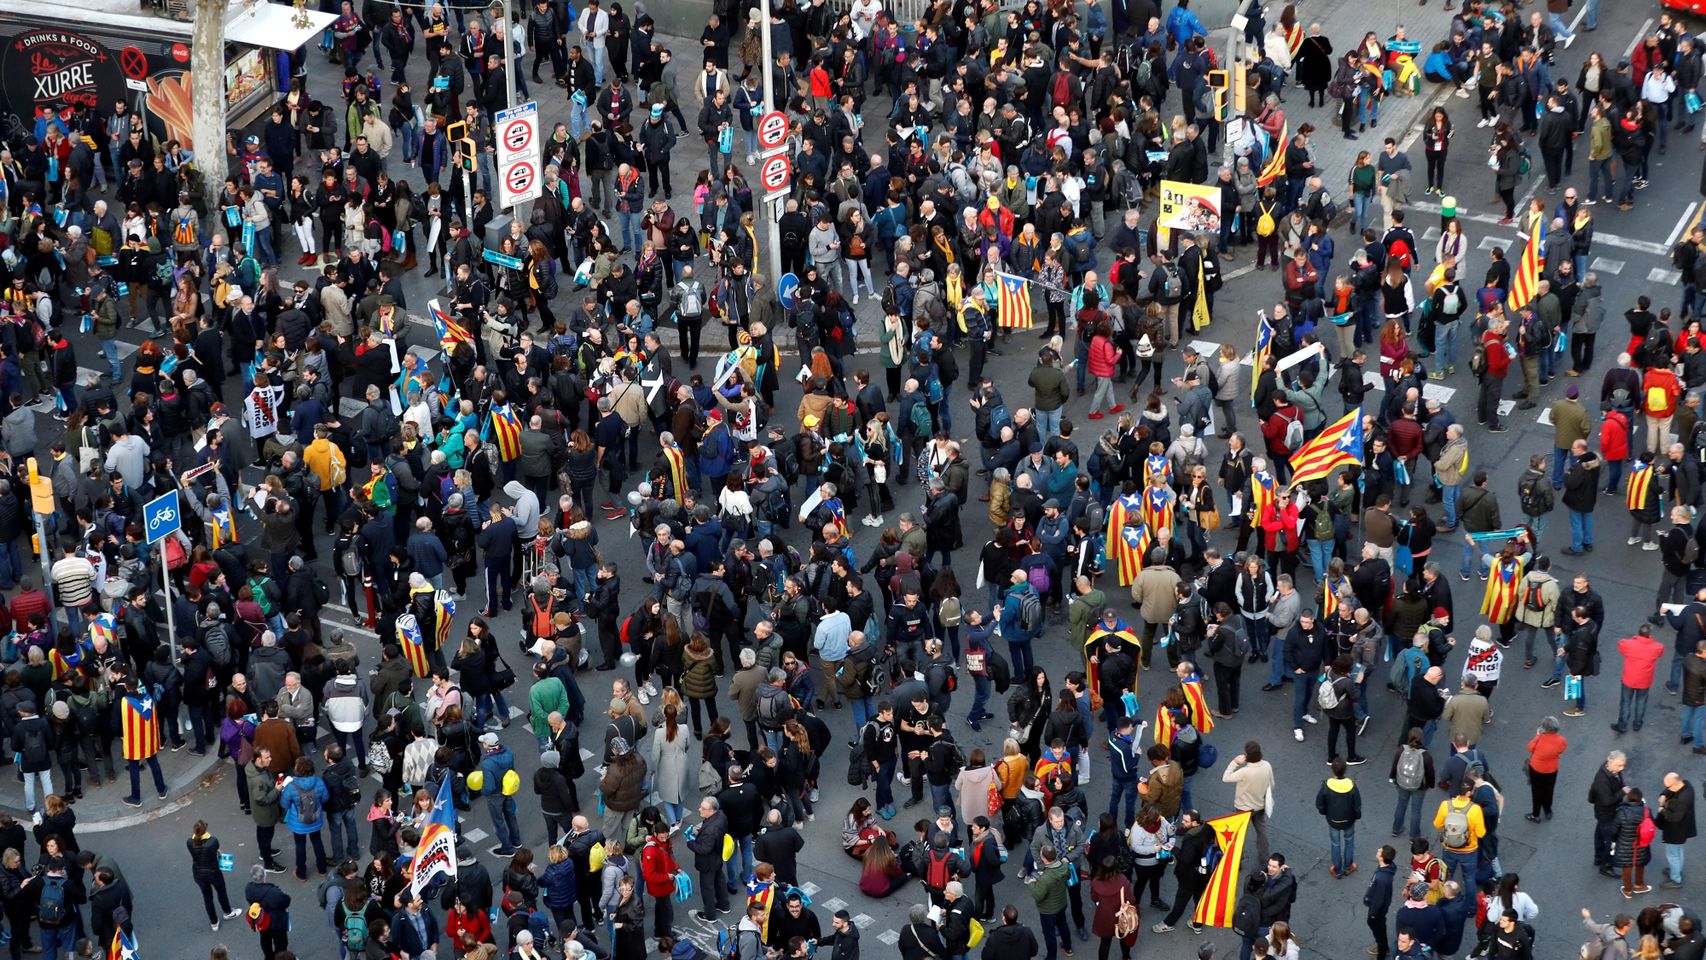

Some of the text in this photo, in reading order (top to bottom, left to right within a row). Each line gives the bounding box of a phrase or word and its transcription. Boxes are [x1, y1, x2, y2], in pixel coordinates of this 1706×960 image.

[24, 34, 98, 54] DRINKS & FOOD
[34, 63, 94, 98] XURRE
